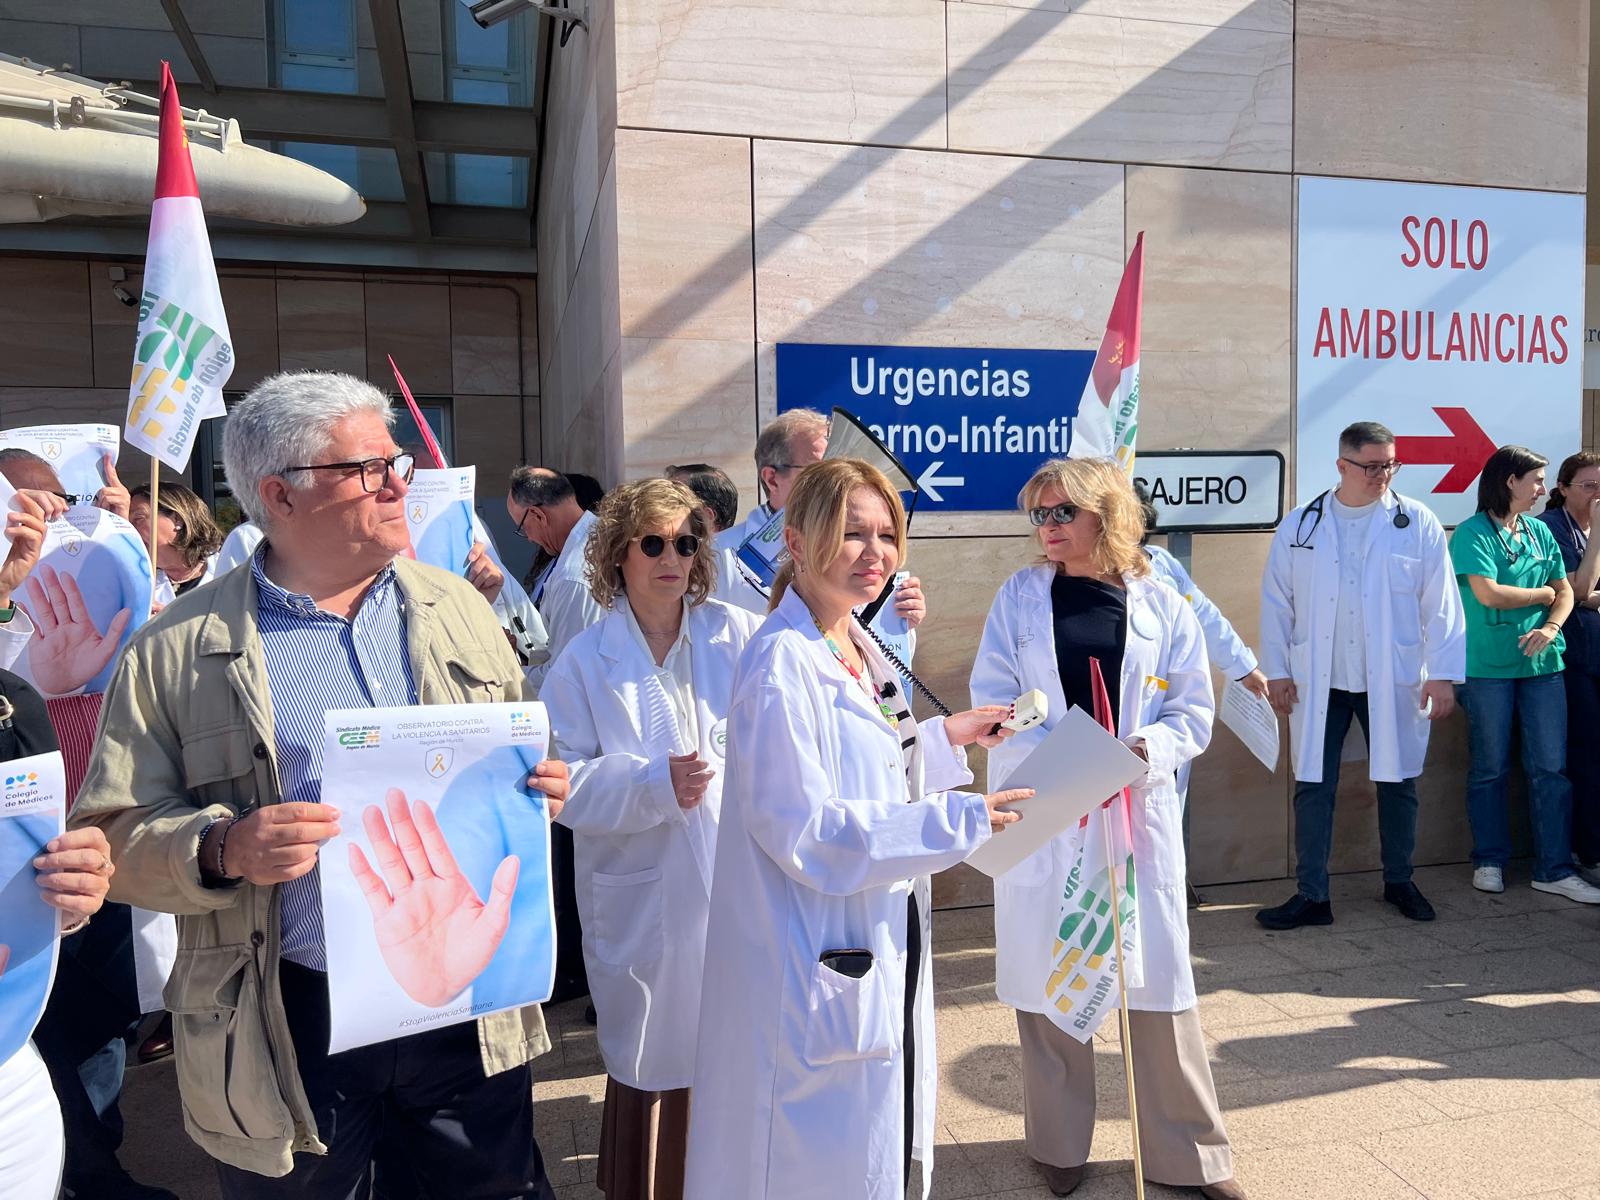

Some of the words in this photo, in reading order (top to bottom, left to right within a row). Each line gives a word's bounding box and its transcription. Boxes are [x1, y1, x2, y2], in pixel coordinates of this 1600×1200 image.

[1400, 215, 1489, 271] SOLO
[1312, 307, 1569, 365] AMBULANCIAS
[850, 357, 1031, 406] Urgencias
[396, 720, 454, 730] OBSERVATORIO
[454, 718, 484, 727] CONTRA
[402, 730, 442, 739] VIOLENCIA
[448, 727, 490, 736] SANITARIOS
[5, 789, 39, 799] Colegio
[399, 1001, 494, 1026] #StopViolenciaSanitaria
